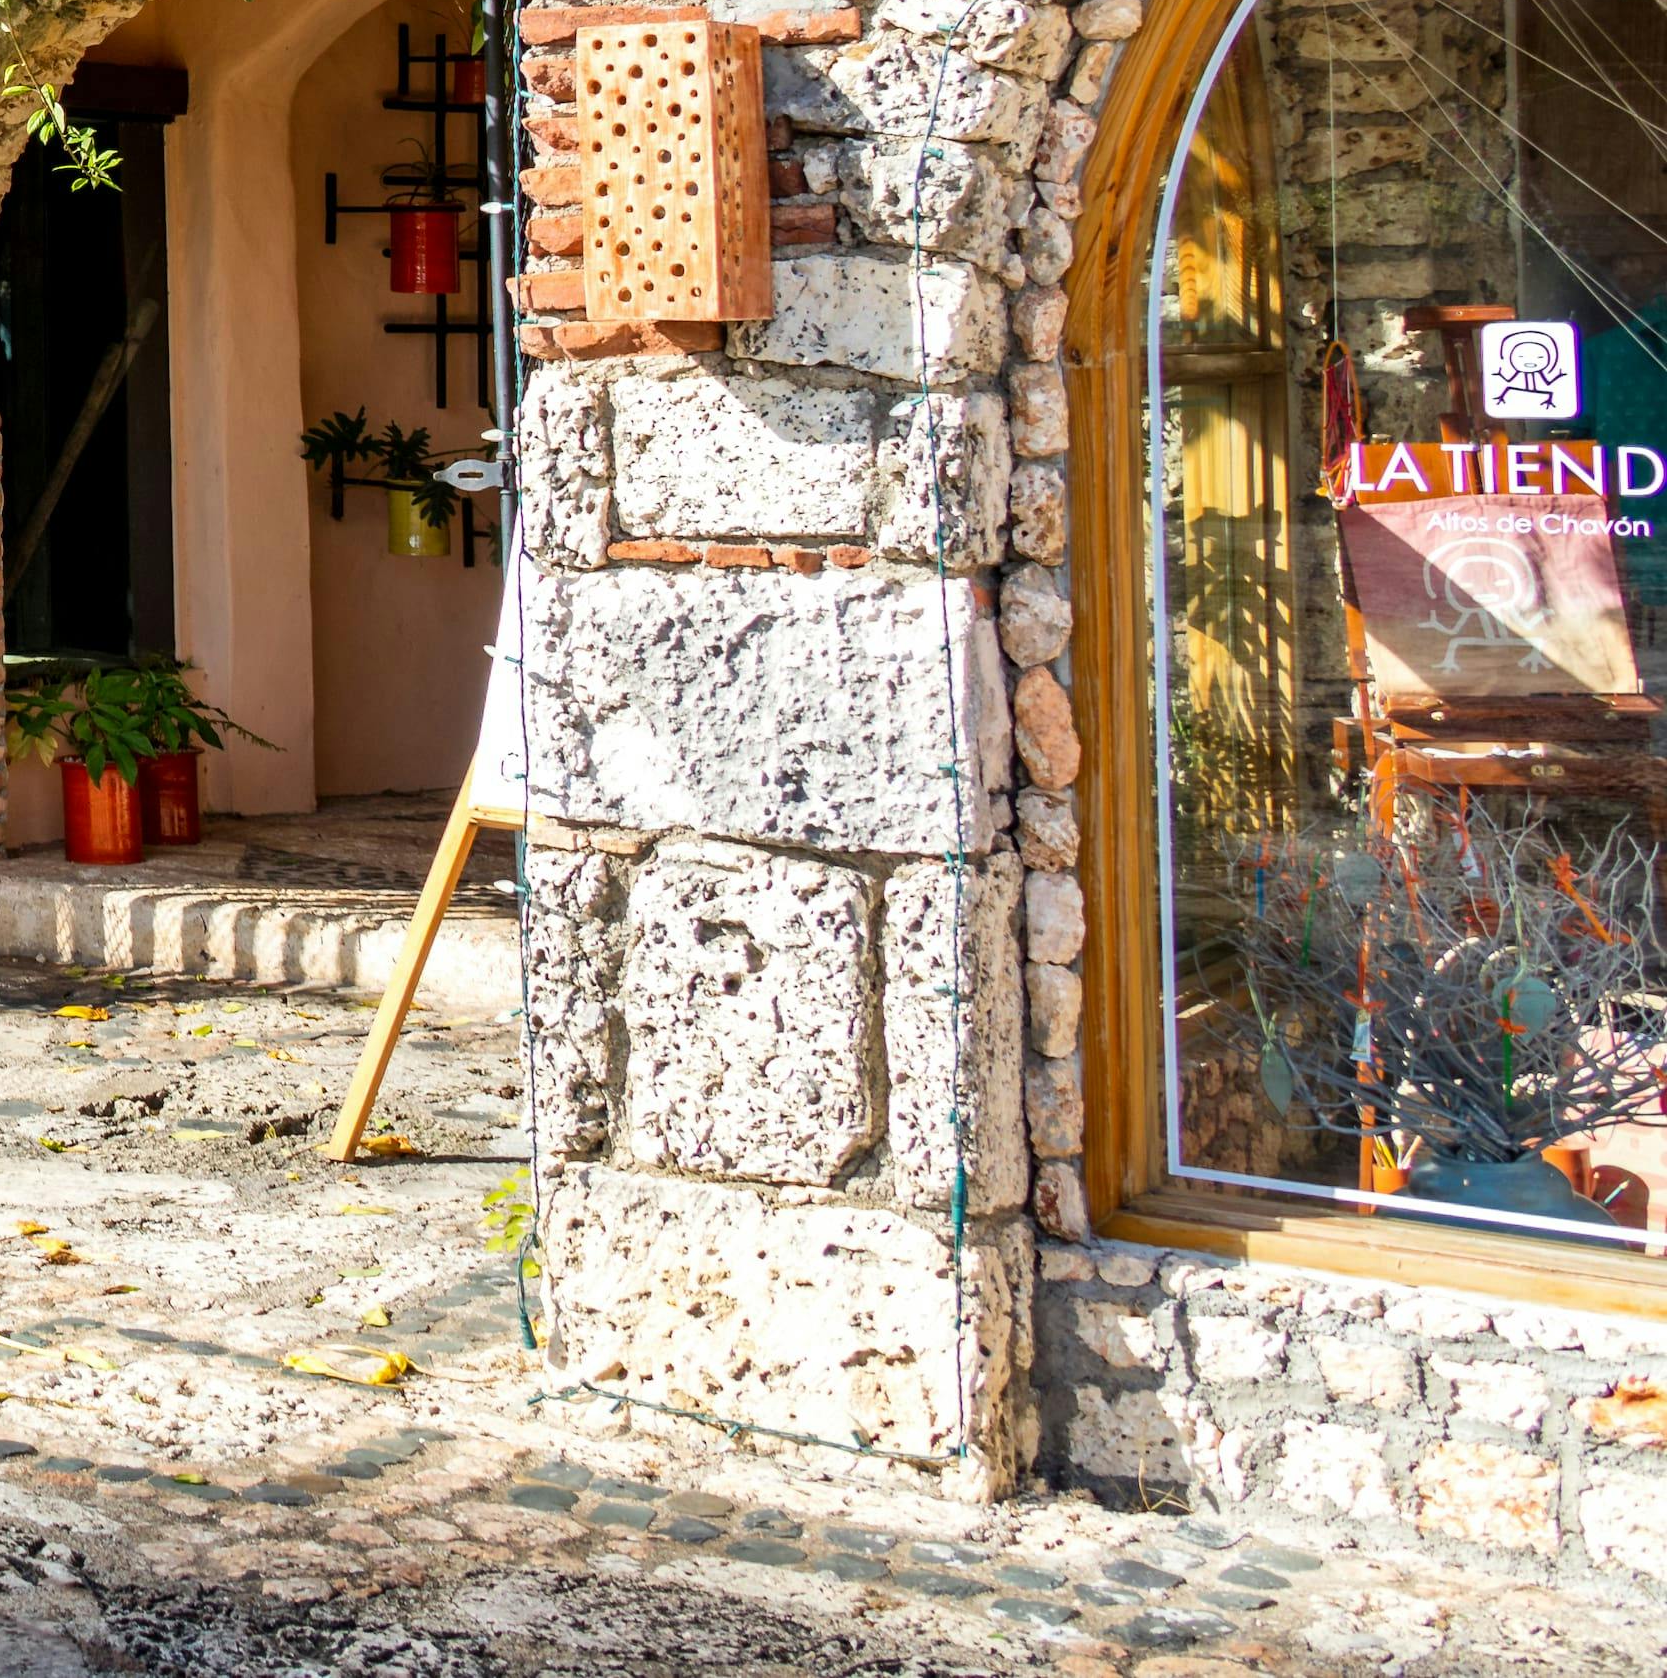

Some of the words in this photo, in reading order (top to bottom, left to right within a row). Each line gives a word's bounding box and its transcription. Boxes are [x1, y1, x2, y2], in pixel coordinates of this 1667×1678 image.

[1350, 441, 1429, 493] LA
[1426, 512, 1489, 533] Altos
[1496, 513, 1533, 534] de
[1540, 513, 1651, 538] Chavón
